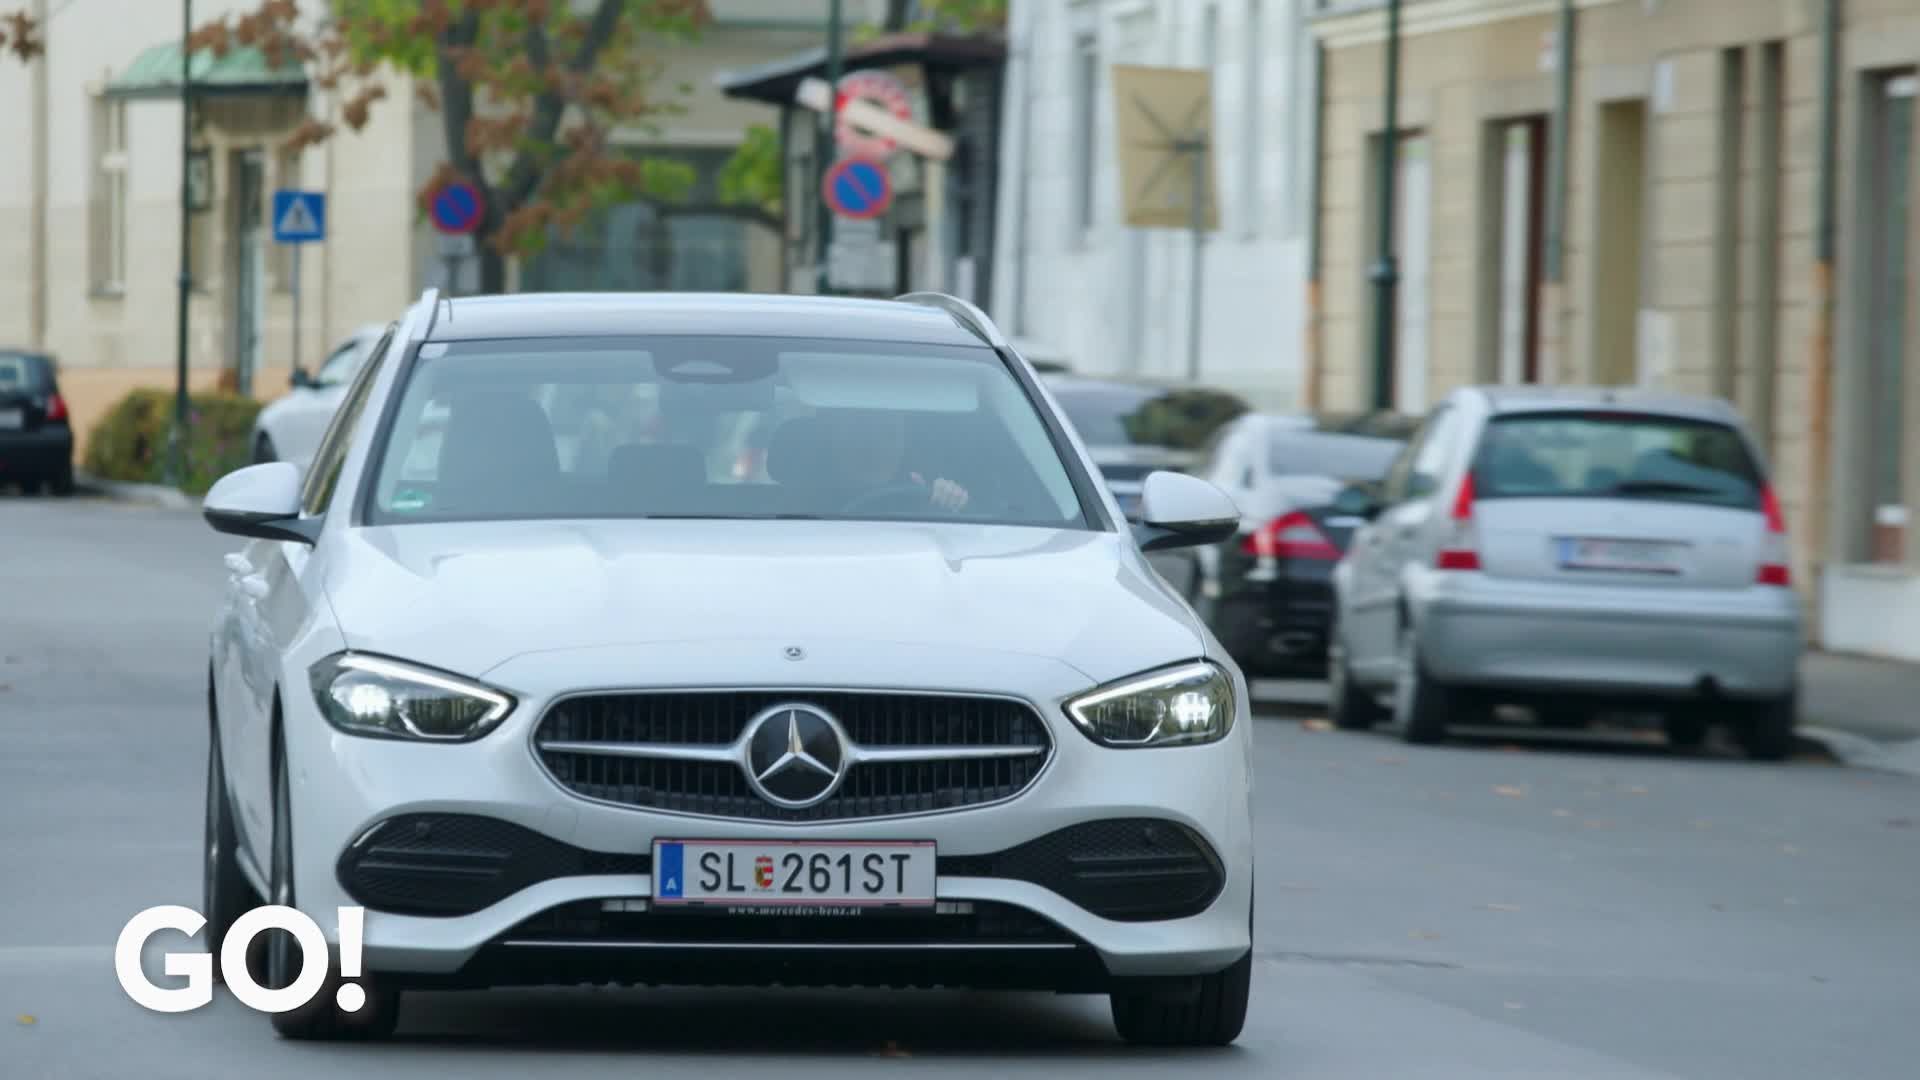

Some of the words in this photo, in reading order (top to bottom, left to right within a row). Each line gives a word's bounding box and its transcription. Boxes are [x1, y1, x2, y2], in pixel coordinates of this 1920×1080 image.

[665, 877, 677, 892] A
[700, 851, 745, 892] SL
[728, 905, 861, 916] www.mercedes-benz.at
